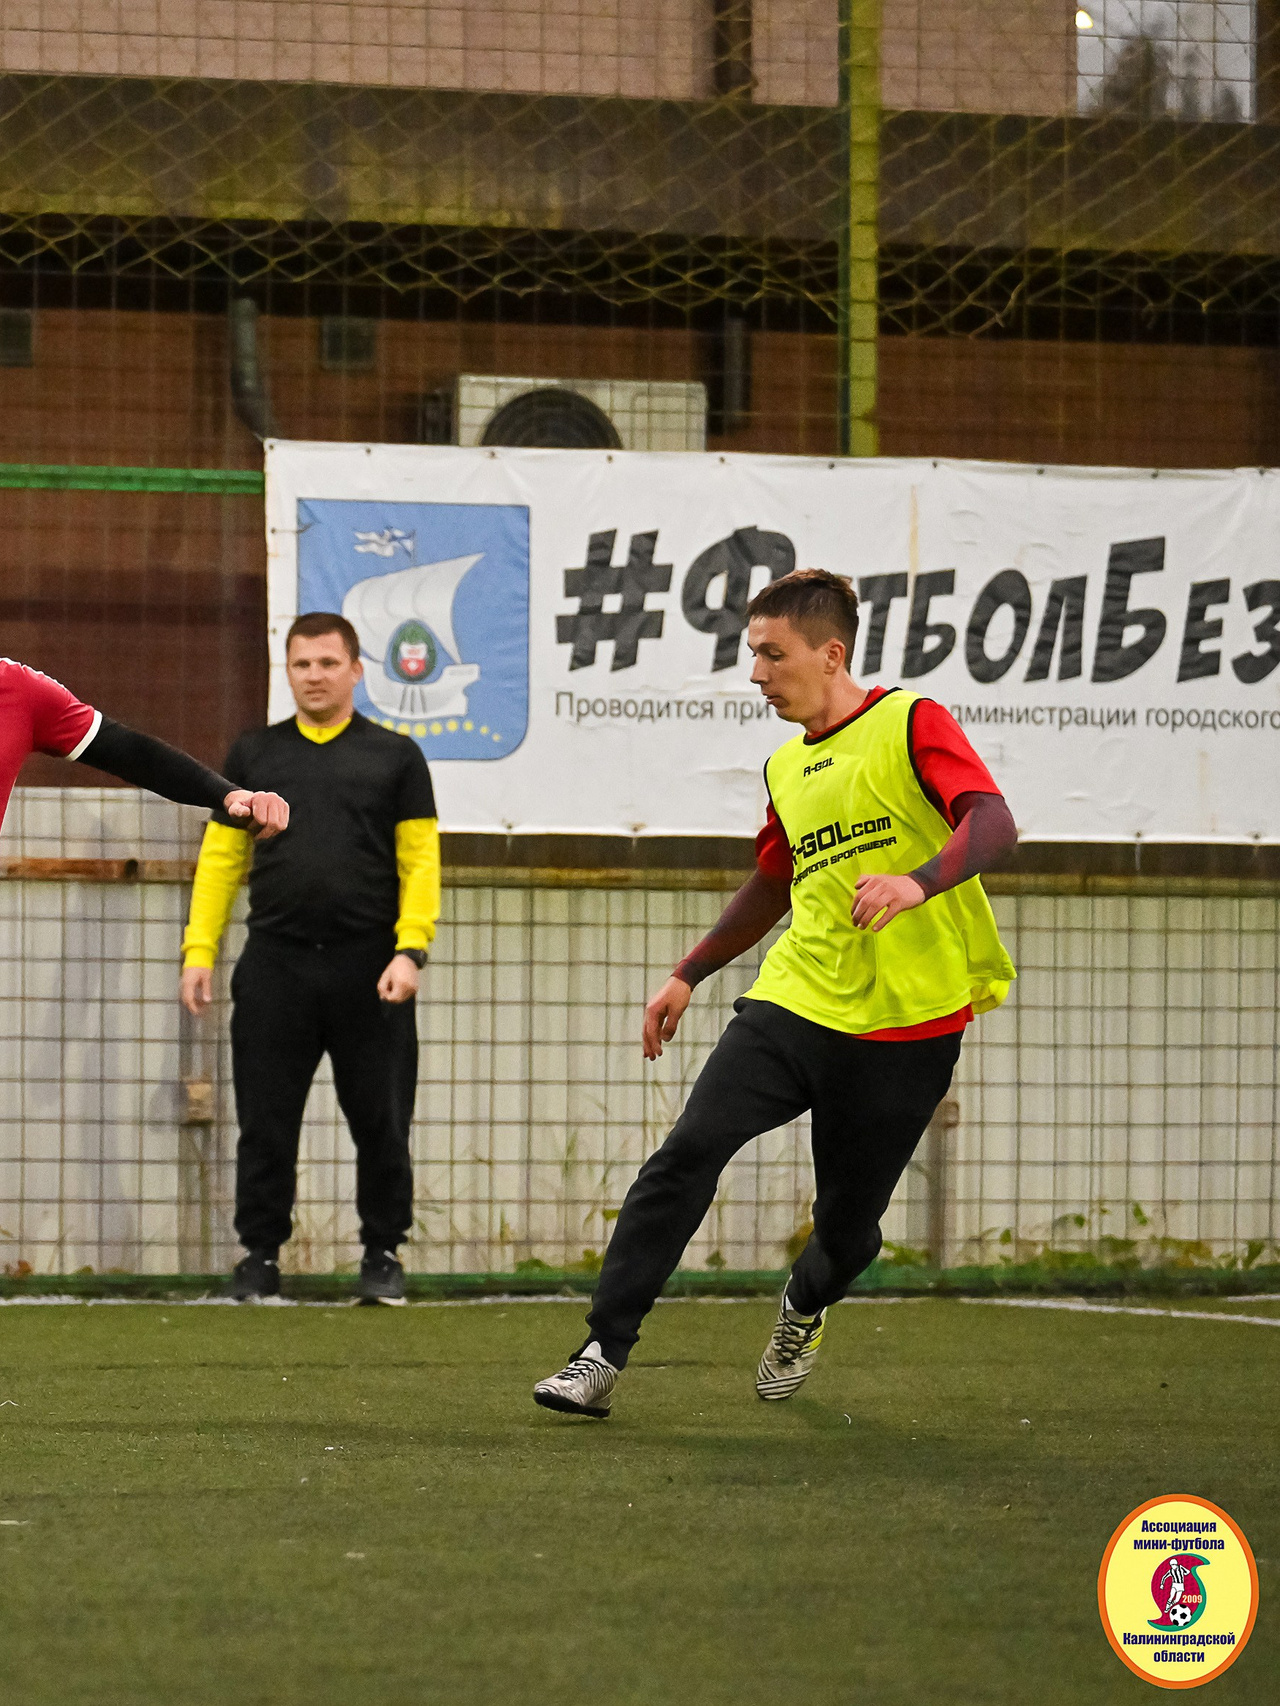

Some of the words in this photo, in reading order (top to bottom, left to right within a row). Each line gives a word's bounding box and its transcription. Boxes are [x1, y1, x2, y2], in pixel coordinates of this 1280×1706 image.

[555, 691, 714, 723] Проводится
[724, 699, 770, 725] при
[950, 704, 1136, 731] дминистрации
[1146, 708, 1280, 733] городского
[803, 757, 835, 777] A-GOL
